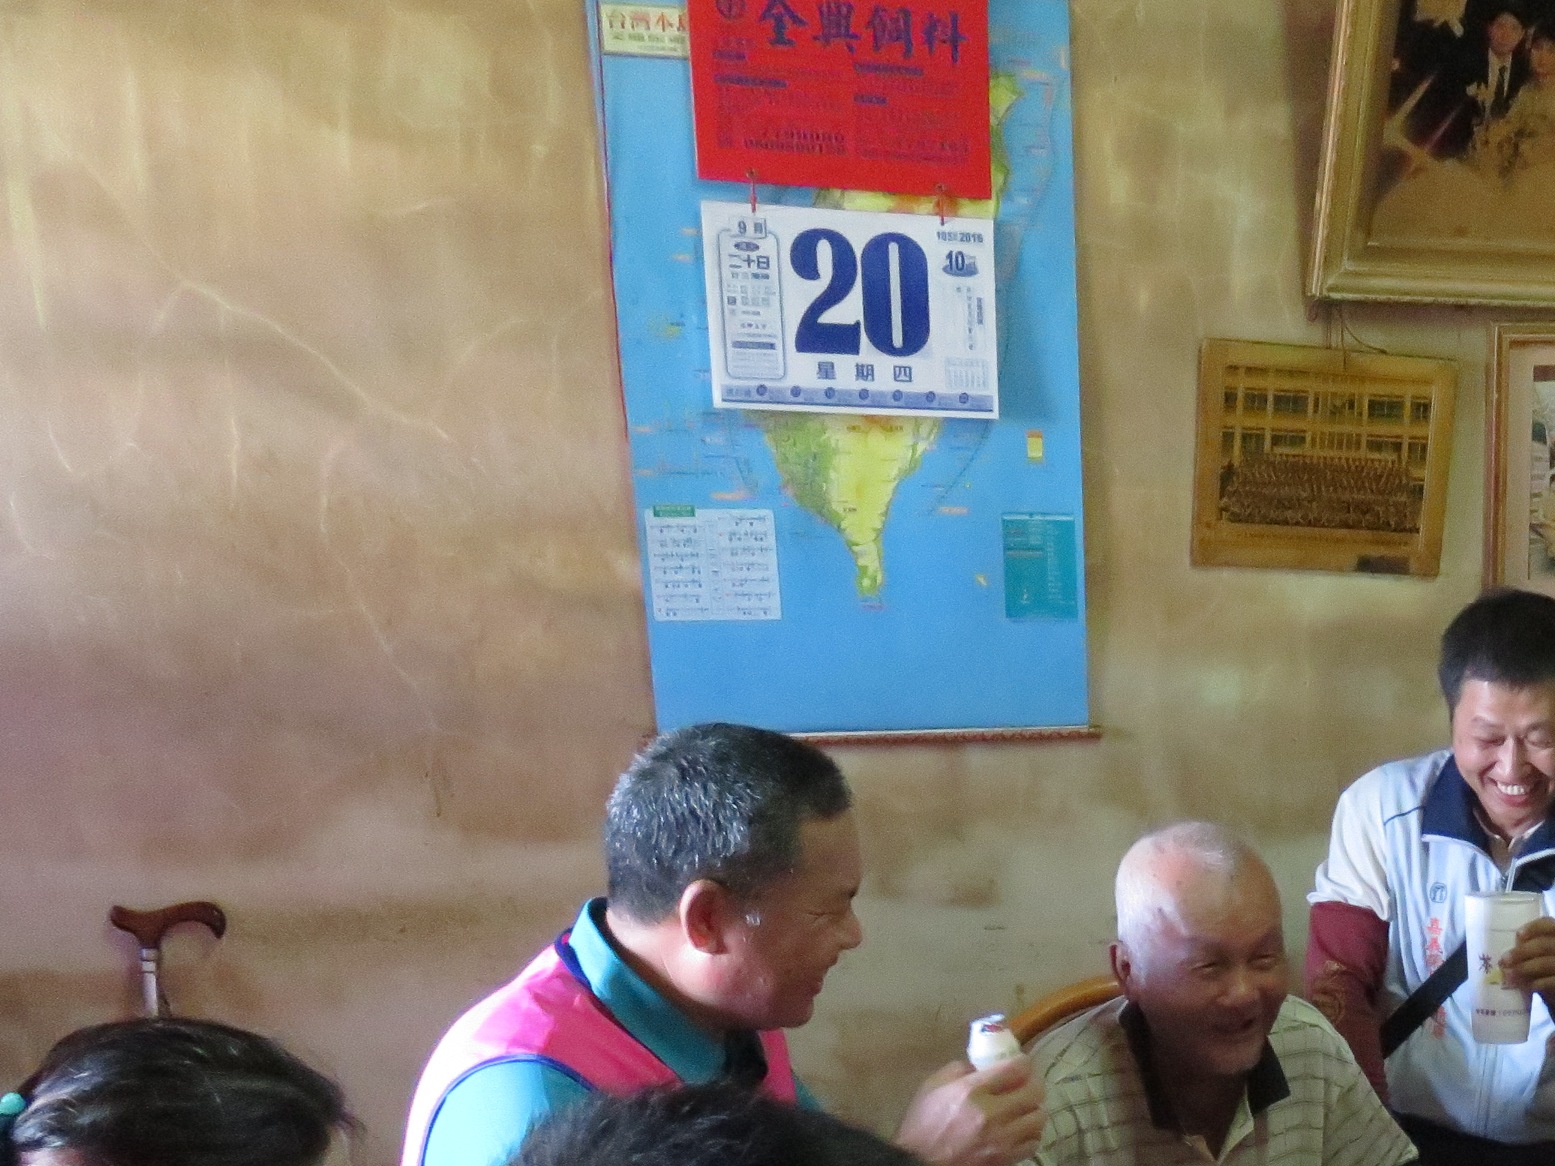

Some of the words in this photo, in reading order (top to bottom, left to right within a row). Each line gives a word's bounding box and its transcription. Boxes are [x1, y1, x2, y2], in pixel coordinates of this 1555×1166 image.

[789, 227, 931, 357] 20
[816, 361, 913, 383] 星期四
